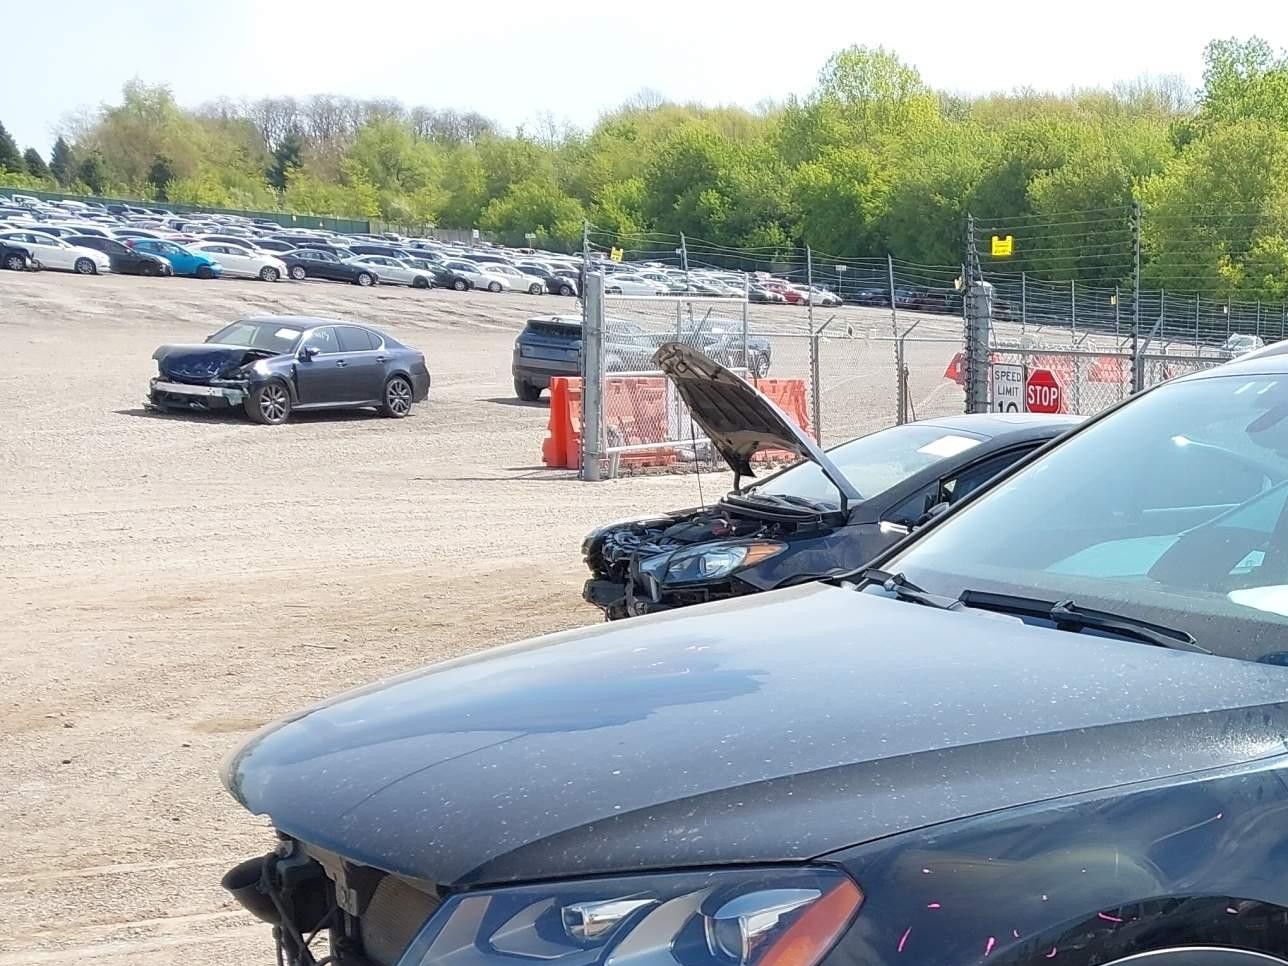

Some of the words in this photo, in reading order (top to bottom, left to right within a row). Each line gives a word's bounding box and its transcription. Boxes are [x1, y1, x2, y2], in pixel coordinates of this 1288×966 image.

[994, 370, 1021, 382] SPEED
[998, 385, 1019, 396] LIMIT
[1028, 385, 1058, 406] STOP
